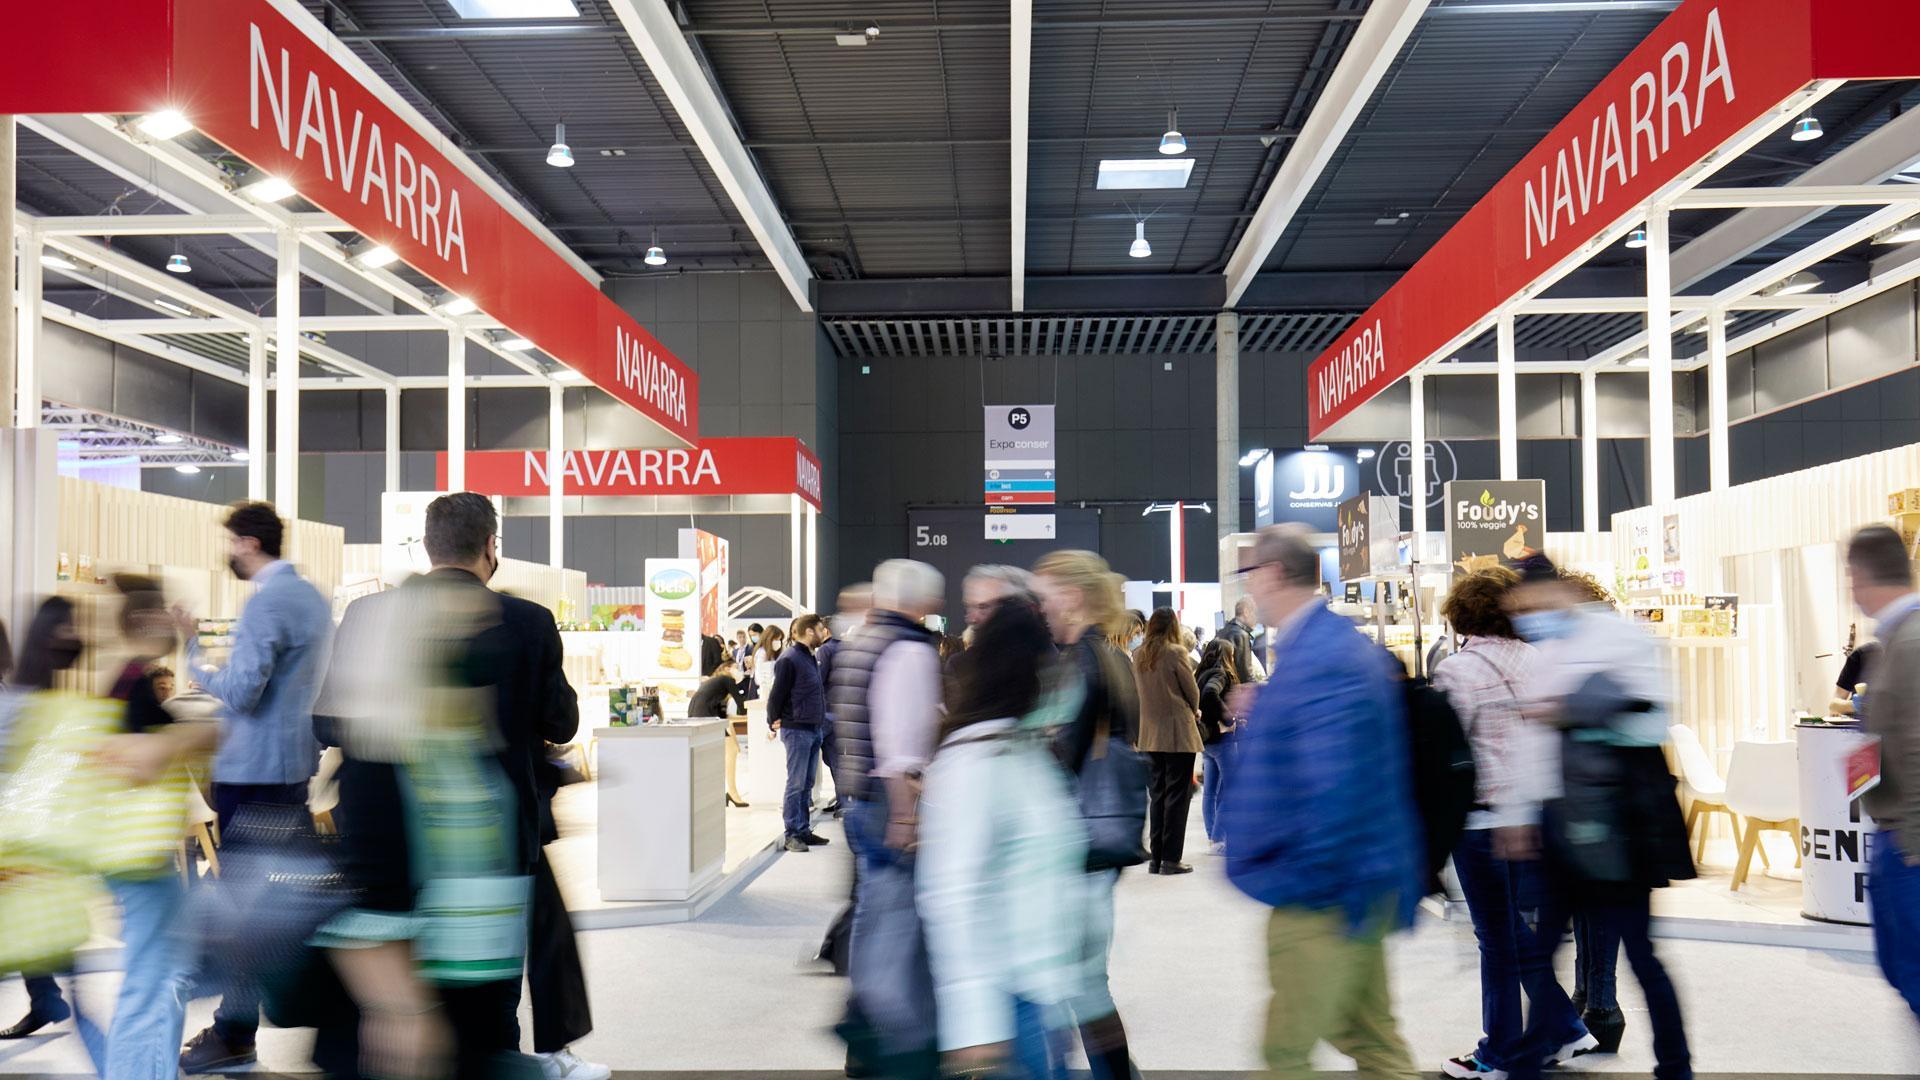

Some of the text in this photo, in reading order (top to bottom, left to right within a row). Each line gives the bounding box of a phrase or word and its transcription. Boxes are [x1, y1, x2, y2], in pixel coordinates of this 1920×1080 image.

[249, 20, 469, 276] NAVARRA
[1524, 6, 1736, 260] NAVARRA
[616, 325, 687, 428] NAVARRA
[1318, 318, 1386, 419] NAVARRA
[1011, 413, 1027, 424] P5
[989, 439, 1050, 450] Expoconser
[523, 449, 721, 487] NAVARRA
[796, 450, 821, 502] NAVARRA
[1457, 500, 1539, 525] Foody's
[1457, 521, 1507, 530] 100% veggie
[916, 526, 948, 546] 5.08
